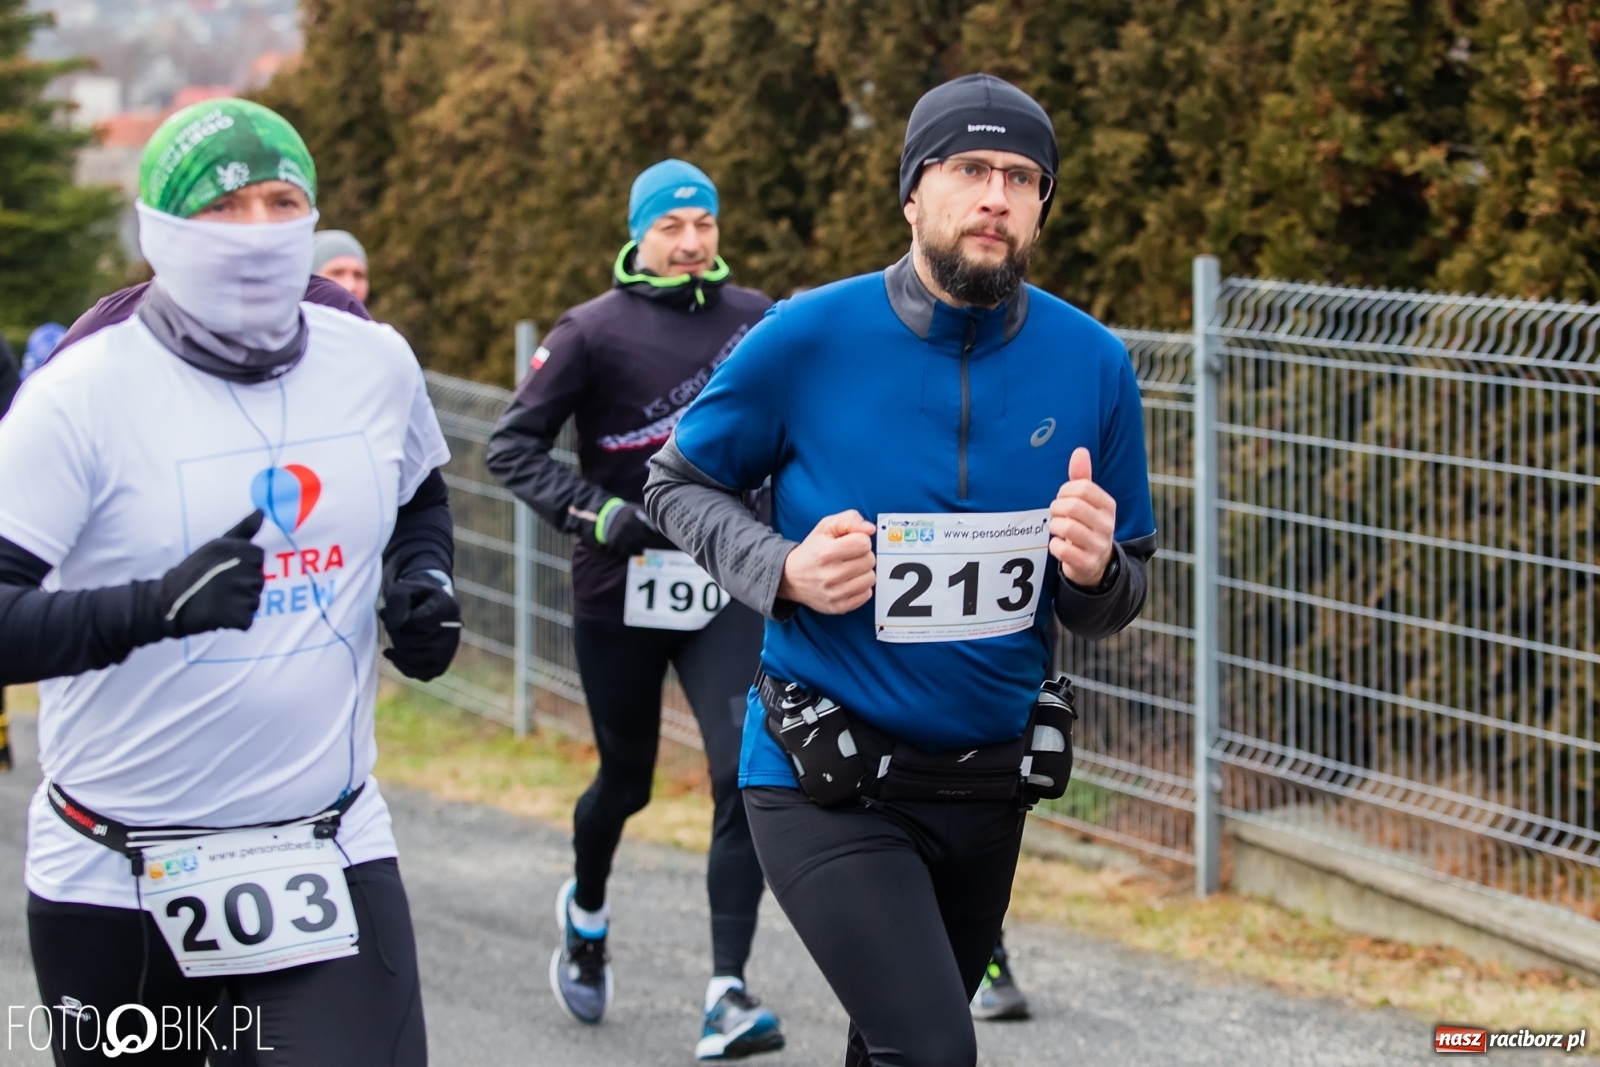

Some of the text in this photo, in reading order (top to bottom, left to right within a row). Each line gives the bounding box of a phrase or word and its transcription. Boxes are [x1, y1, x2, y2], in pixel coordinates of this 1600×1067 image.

[943, 523, 1044, 540] www.personalbest.pl
[261, 545, 345, 580] LTRA
[254, 580, 336, 618] REW
[638, 579, 722, 612] 190
[887, 558, 1035, 618] 213
[166, 873, 338, 953] 203
